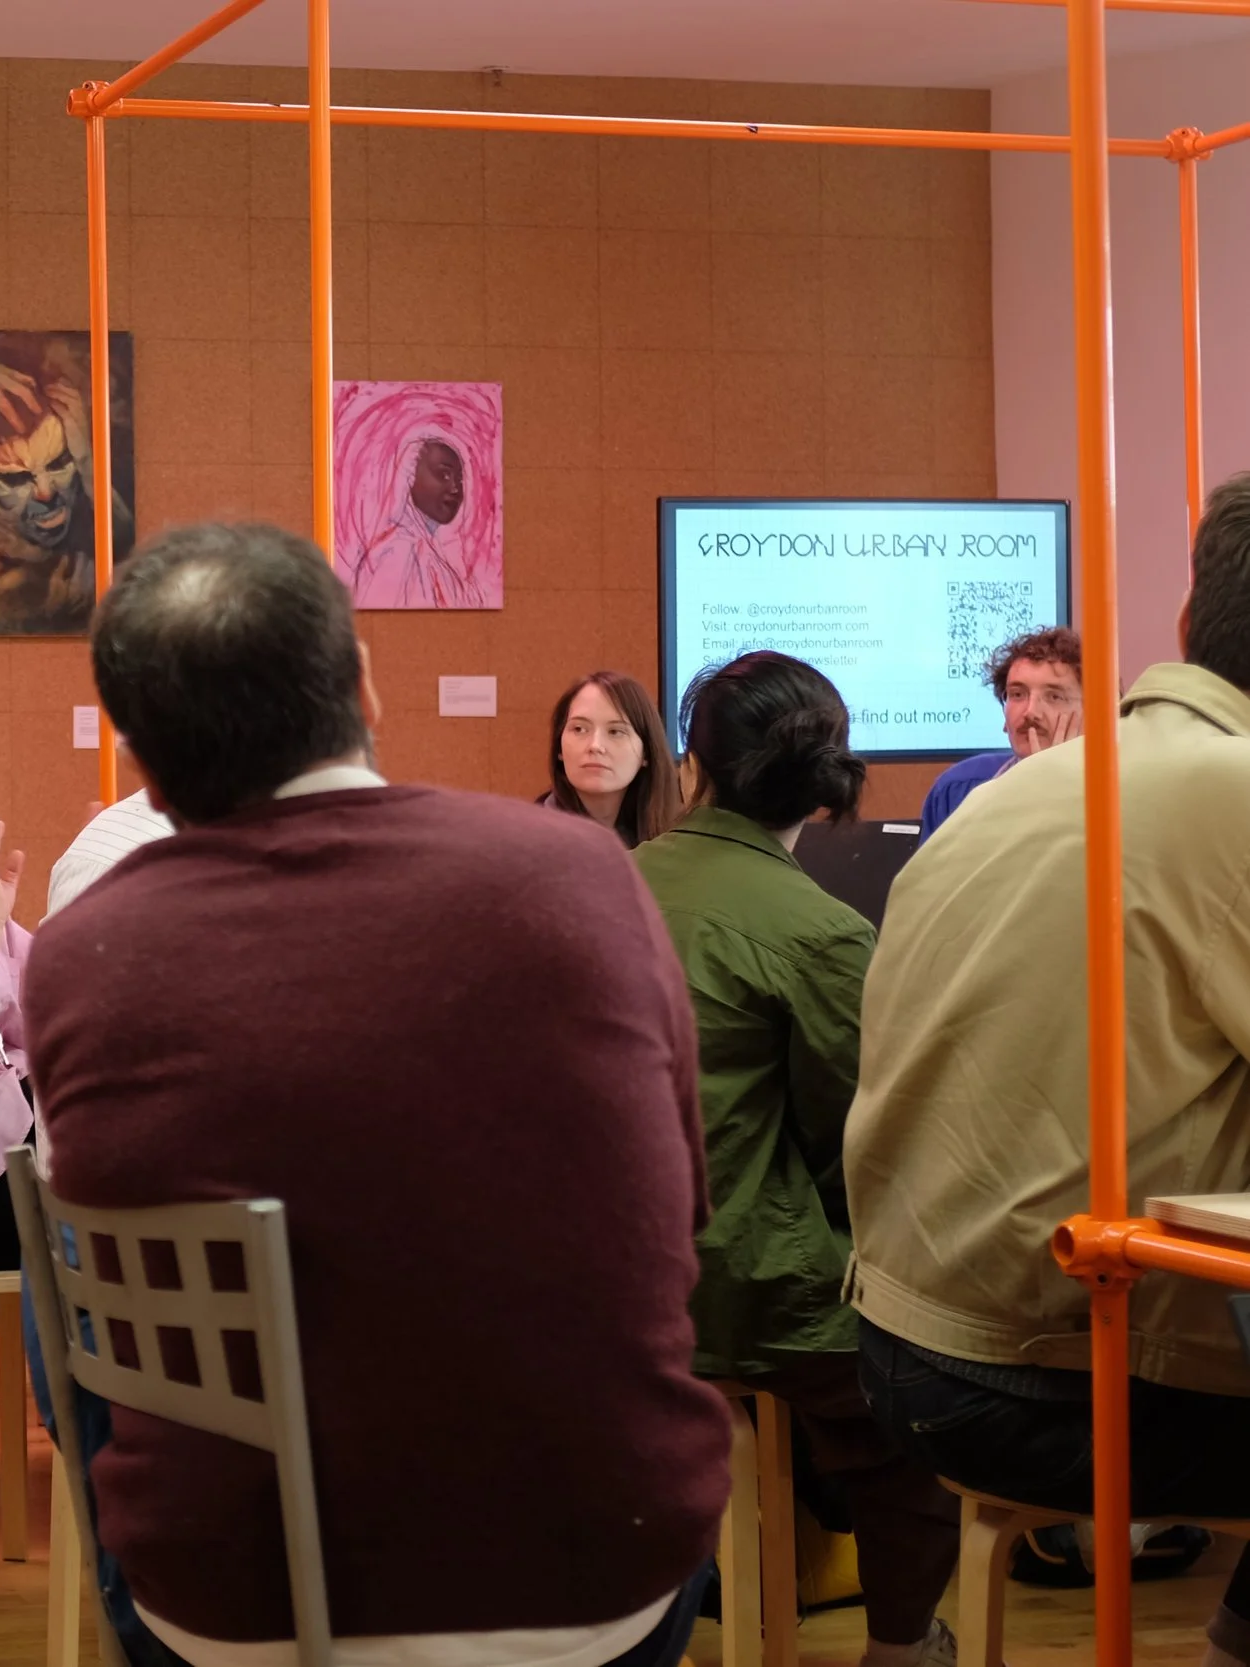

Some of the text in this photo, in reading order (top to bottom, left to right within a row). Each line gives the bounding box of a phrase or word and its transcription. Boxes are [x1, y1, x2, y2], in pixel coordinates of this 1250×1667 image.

[698, 533, 1037, 557] CROYDON URBAN ROOM
[702, 602, 867, 617] Follow: @croydonurbanroom
[701, 620, 869, 633] Visit: croydonurbanroom.com
[742, 637, 883, 651] info@croydonurbanroom
[861, 709, 889, 724] find
[894, 709, 918, 724] out
[923, 707, 971, 724] more?
